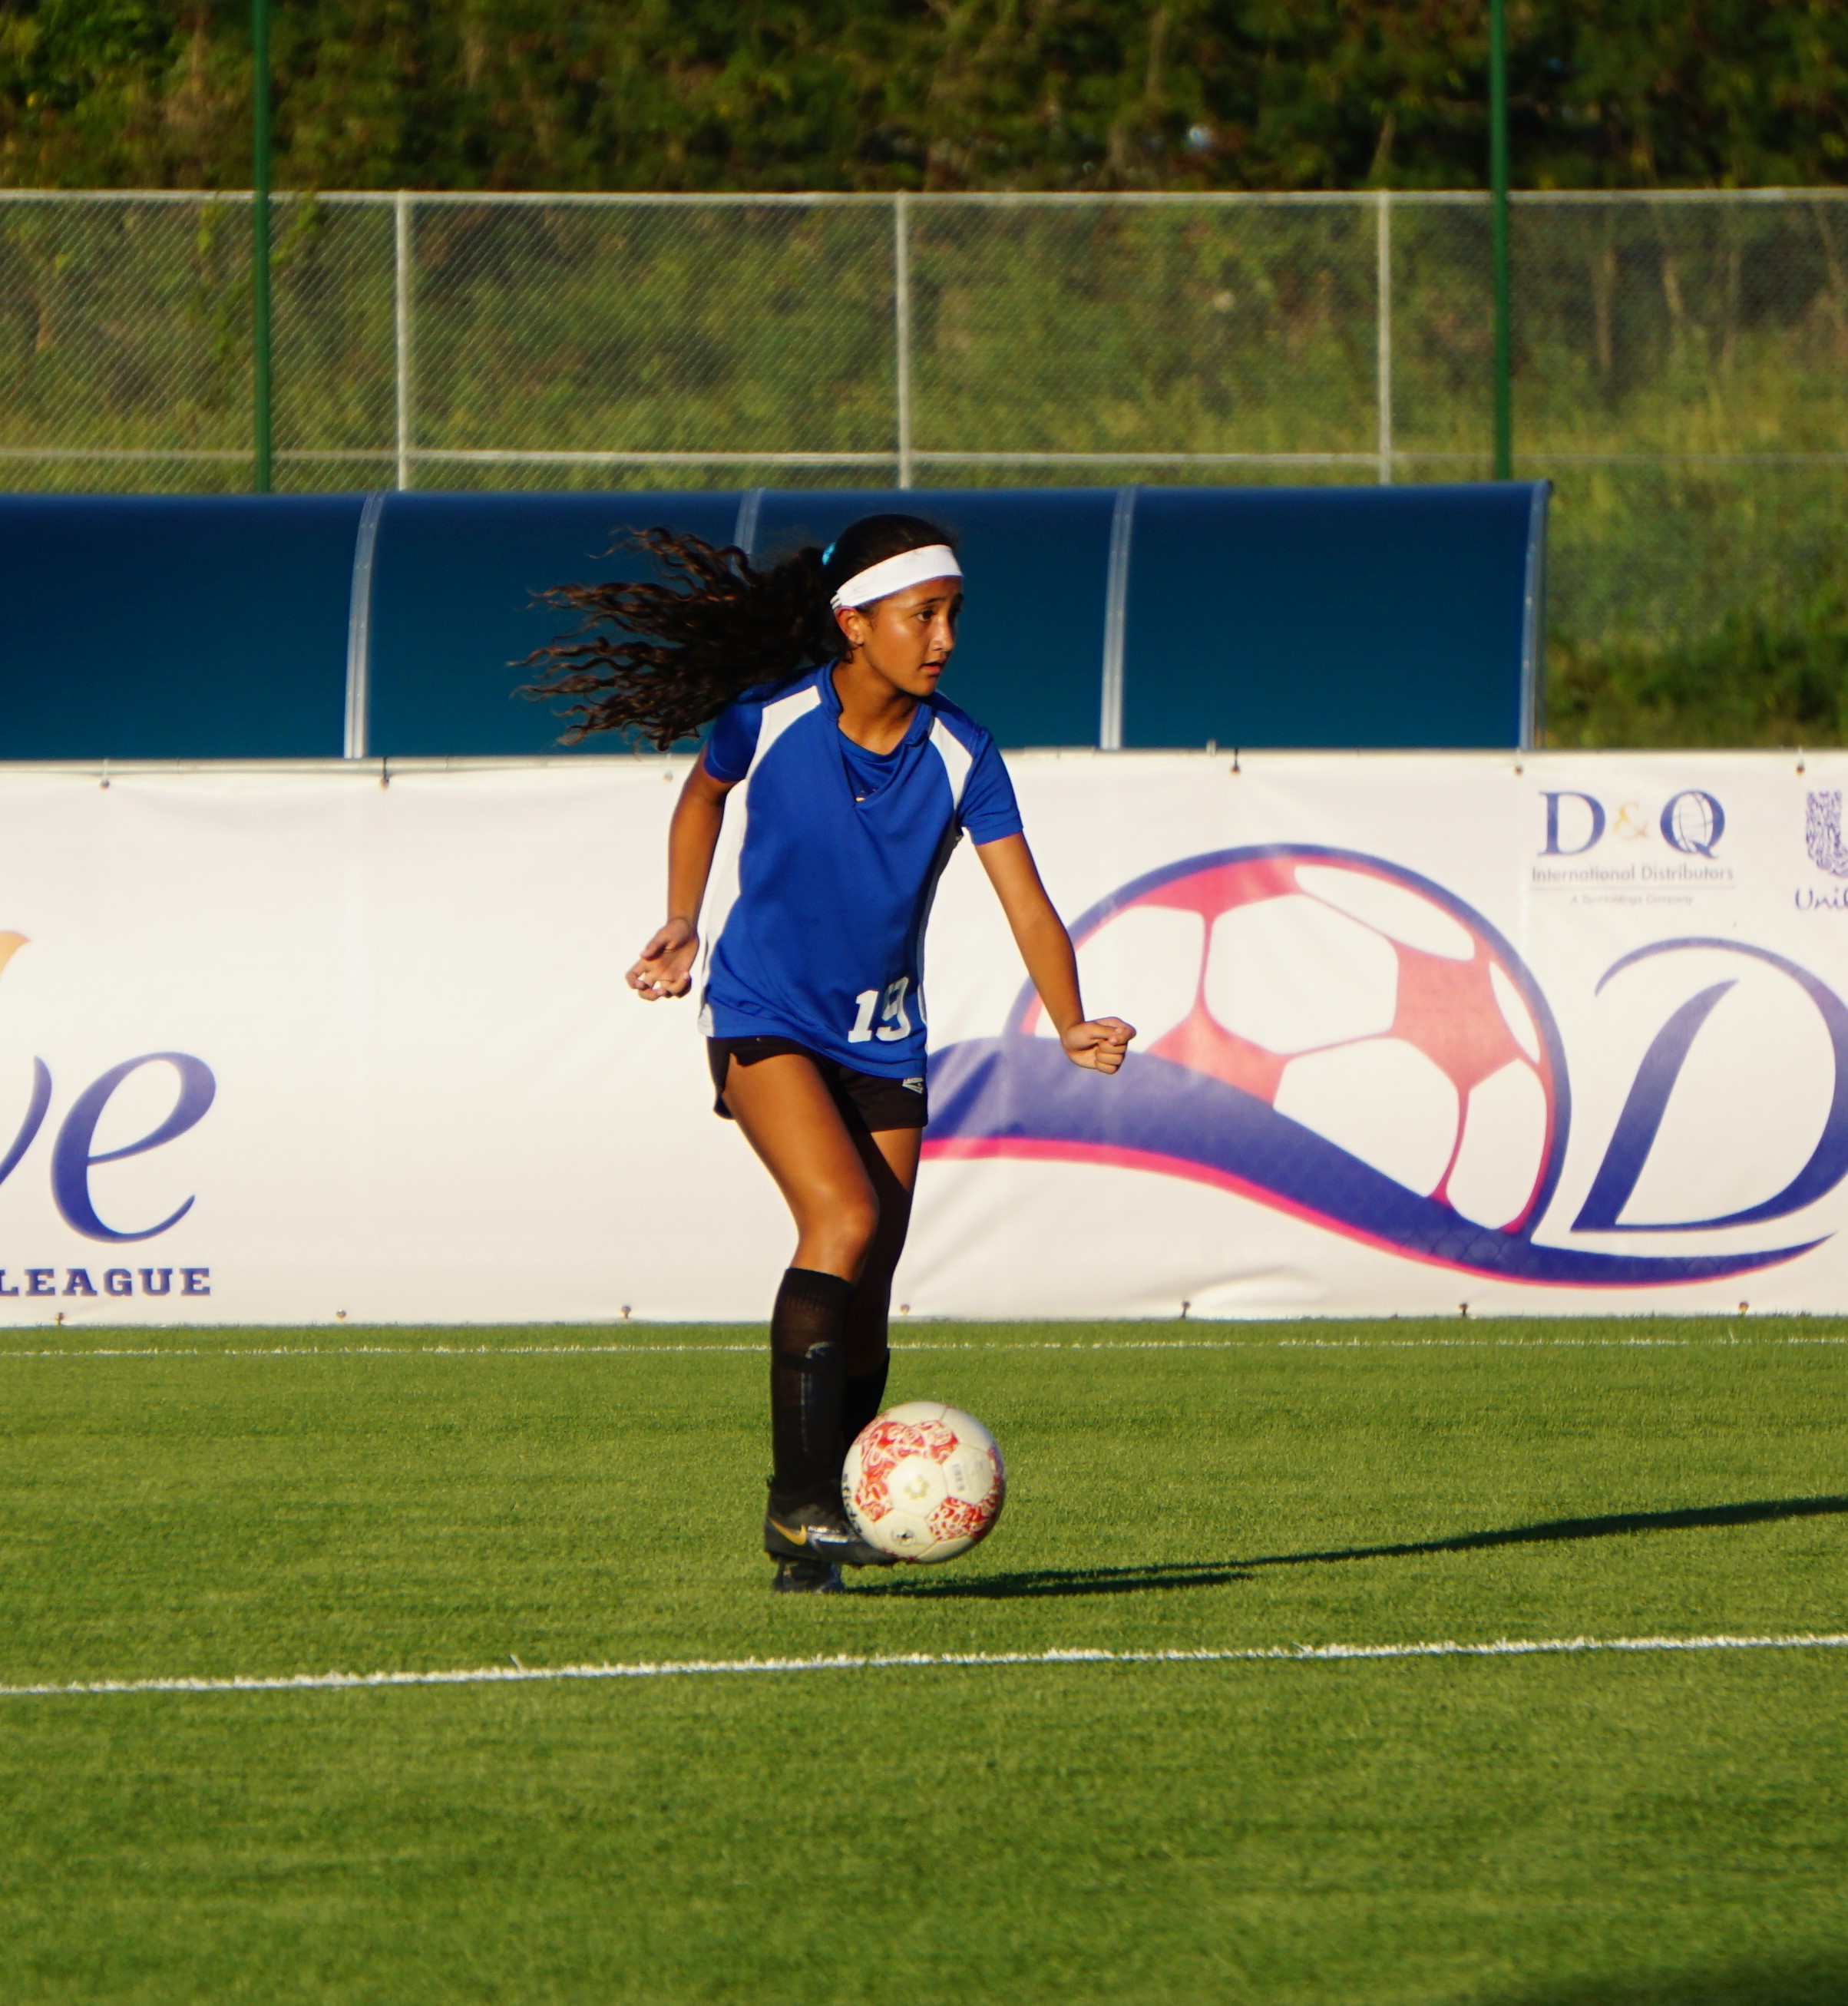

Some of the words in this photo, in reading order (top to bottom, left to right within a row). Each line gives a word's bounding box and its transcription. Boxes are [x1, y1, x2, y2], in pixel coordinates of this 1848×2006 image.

[1532, 864, 1635, 882] International
[1641, 864, 1734, 881] Distributors
[0, 1268, 210, 1297] LEAGUE
